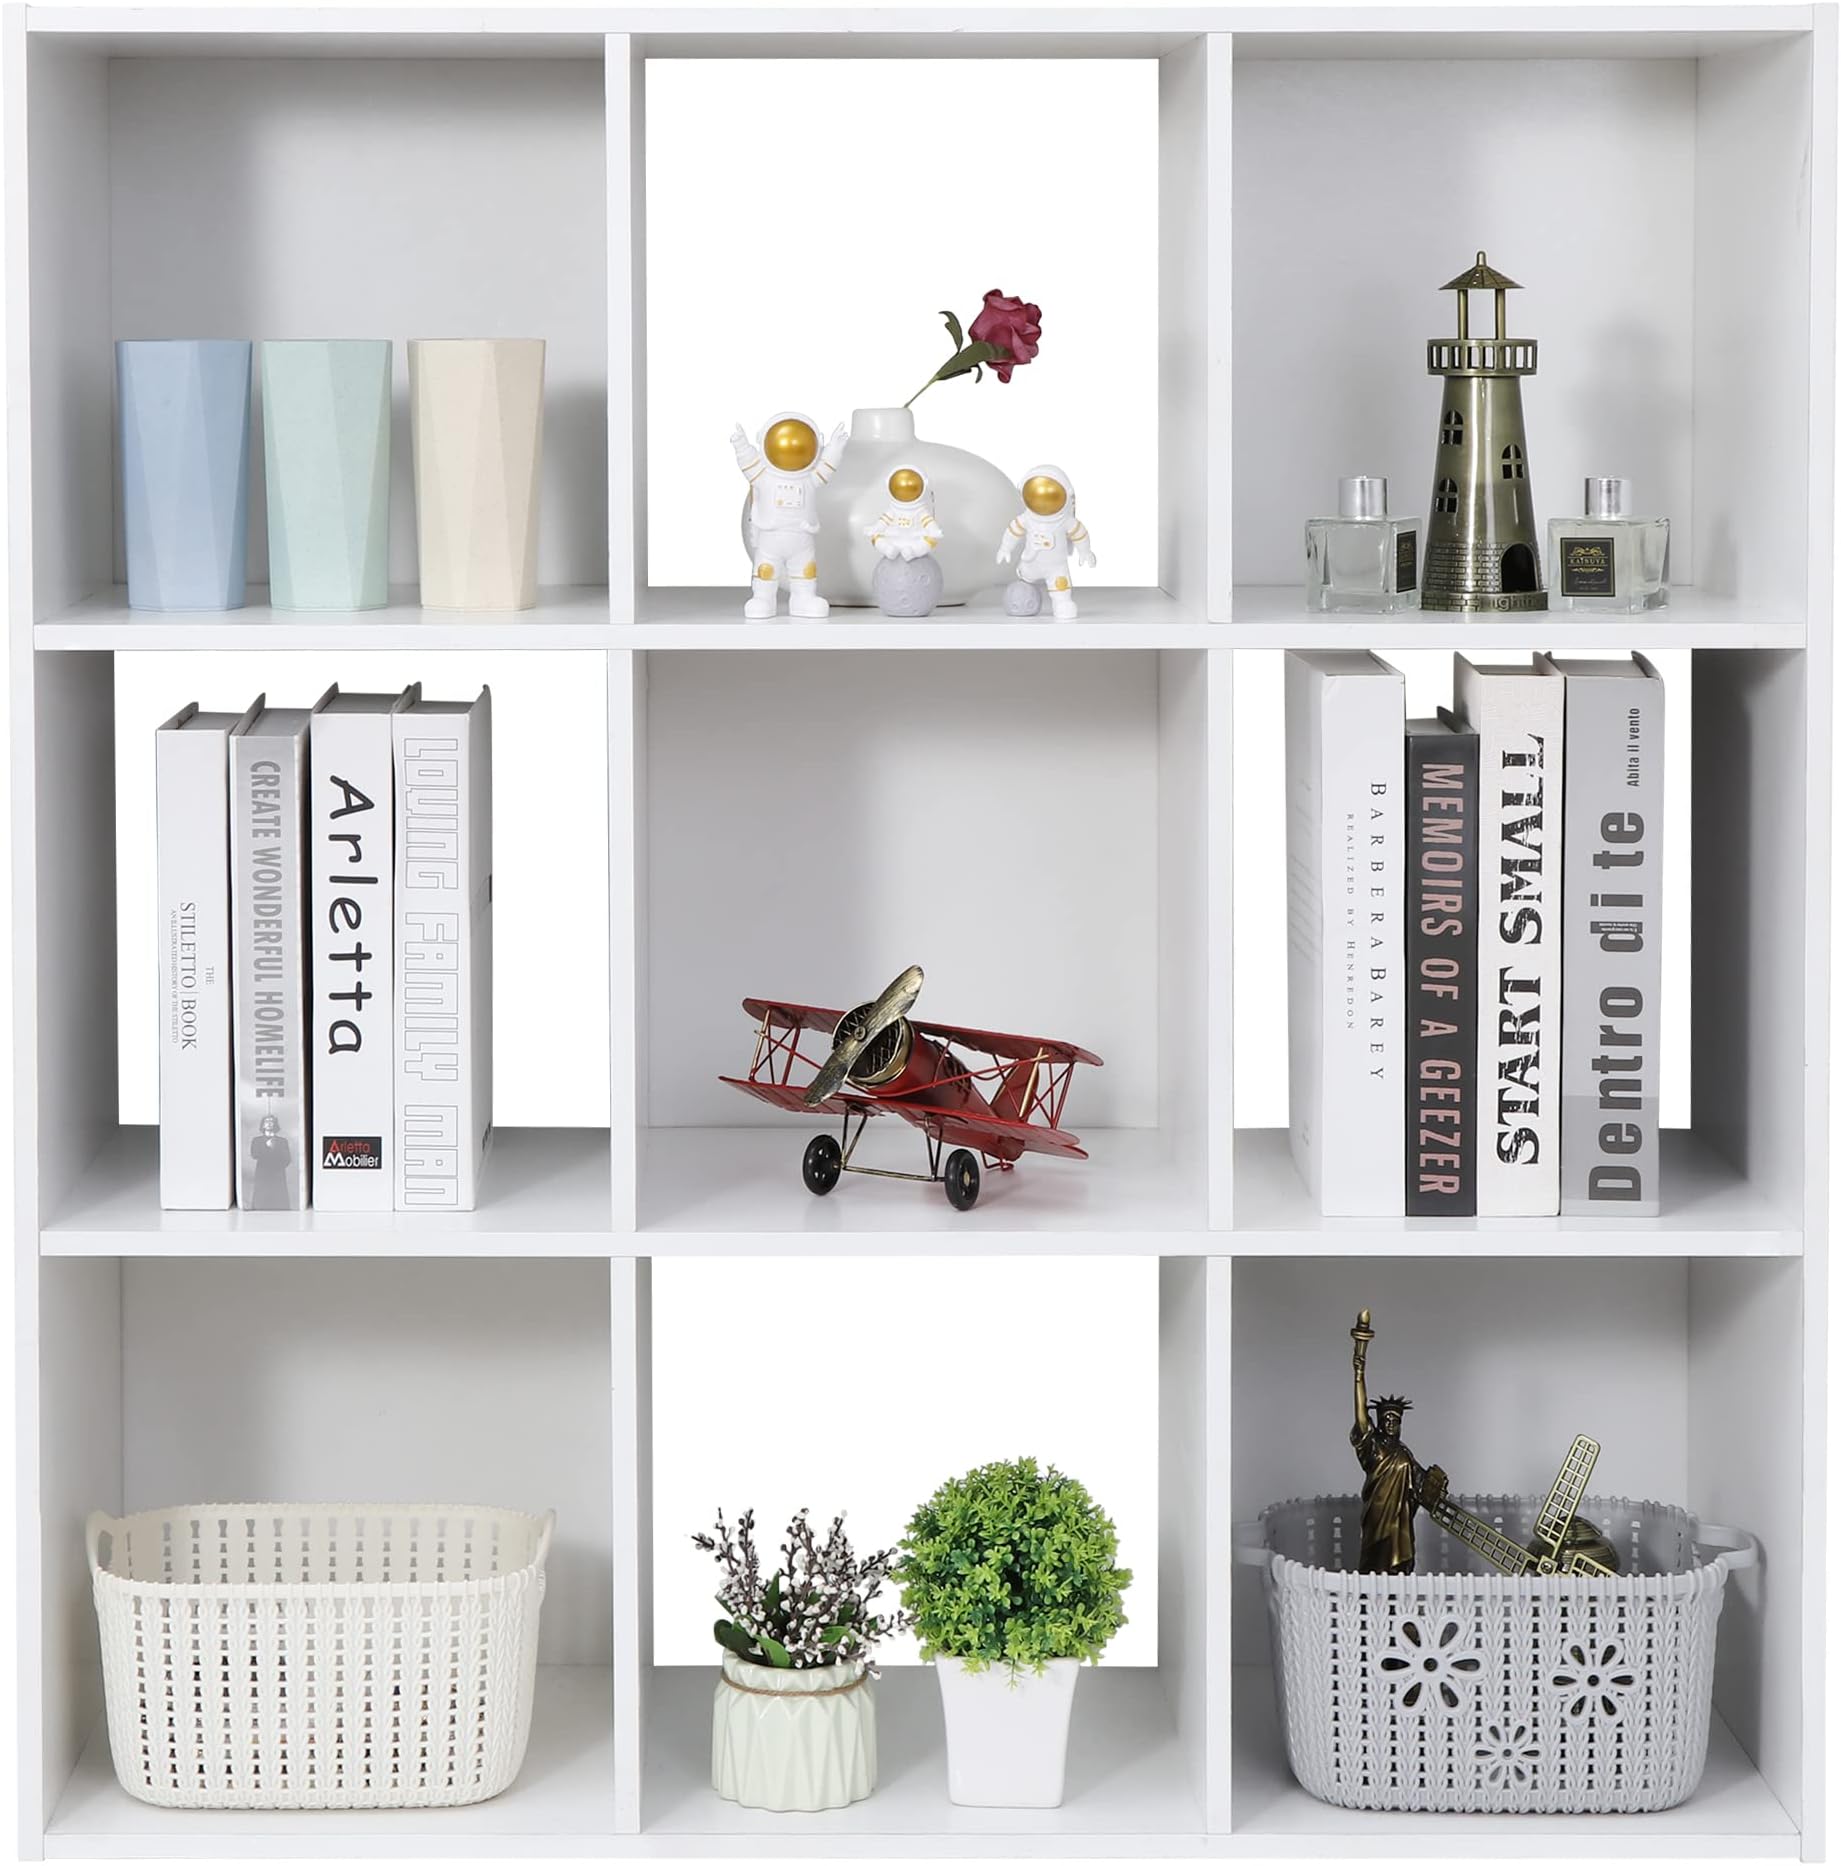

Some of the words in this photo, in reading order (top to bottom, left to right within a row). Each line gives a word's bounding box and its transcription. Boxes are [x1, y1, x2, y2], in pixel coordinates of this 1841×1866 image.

[1627, 708, 1640, 740] vento
[250, 759, 281, 838] CREATE
[403, 736, 459, 890] LOVING
[1627, 757, 1640, 787] Abita
[1346, 813, 1355, 895] REALIZED
[1420, 763, 1465, 937] MEMOIRS
[1499, 733, 1546, 945] SMALL
[1593, 811, 1645, 869] te
[180, 902, 197, 989] STILETTO
[251, 846, 283, 983] WONDERFUL
[327, 774, 379, 1055] Arletta
[1346, 908, 1355, 927] BY
[1590, 893, 1644, 952] di
[205, 966, 214, 985] THE
[403, 911, 459, 1082] FAMILY
[1420, 957, 1460, 1000] OF
[181, 1000, 198, 1050] BOOK
[254, 991, 285, 1098] HOMELIFE
[1419, 1019, 1459, 1038] A
[1496, 966, 1542, 1165] START
[1418, 1059, 1462, 1194] GEEZER
[1588, 987, 1643, 1201] Dentro
[323, 1152, 380, 1167] Mobilier
[330, 1139, 371, 1153] Arletta
[403, 1103, 459, 1206] MAN
